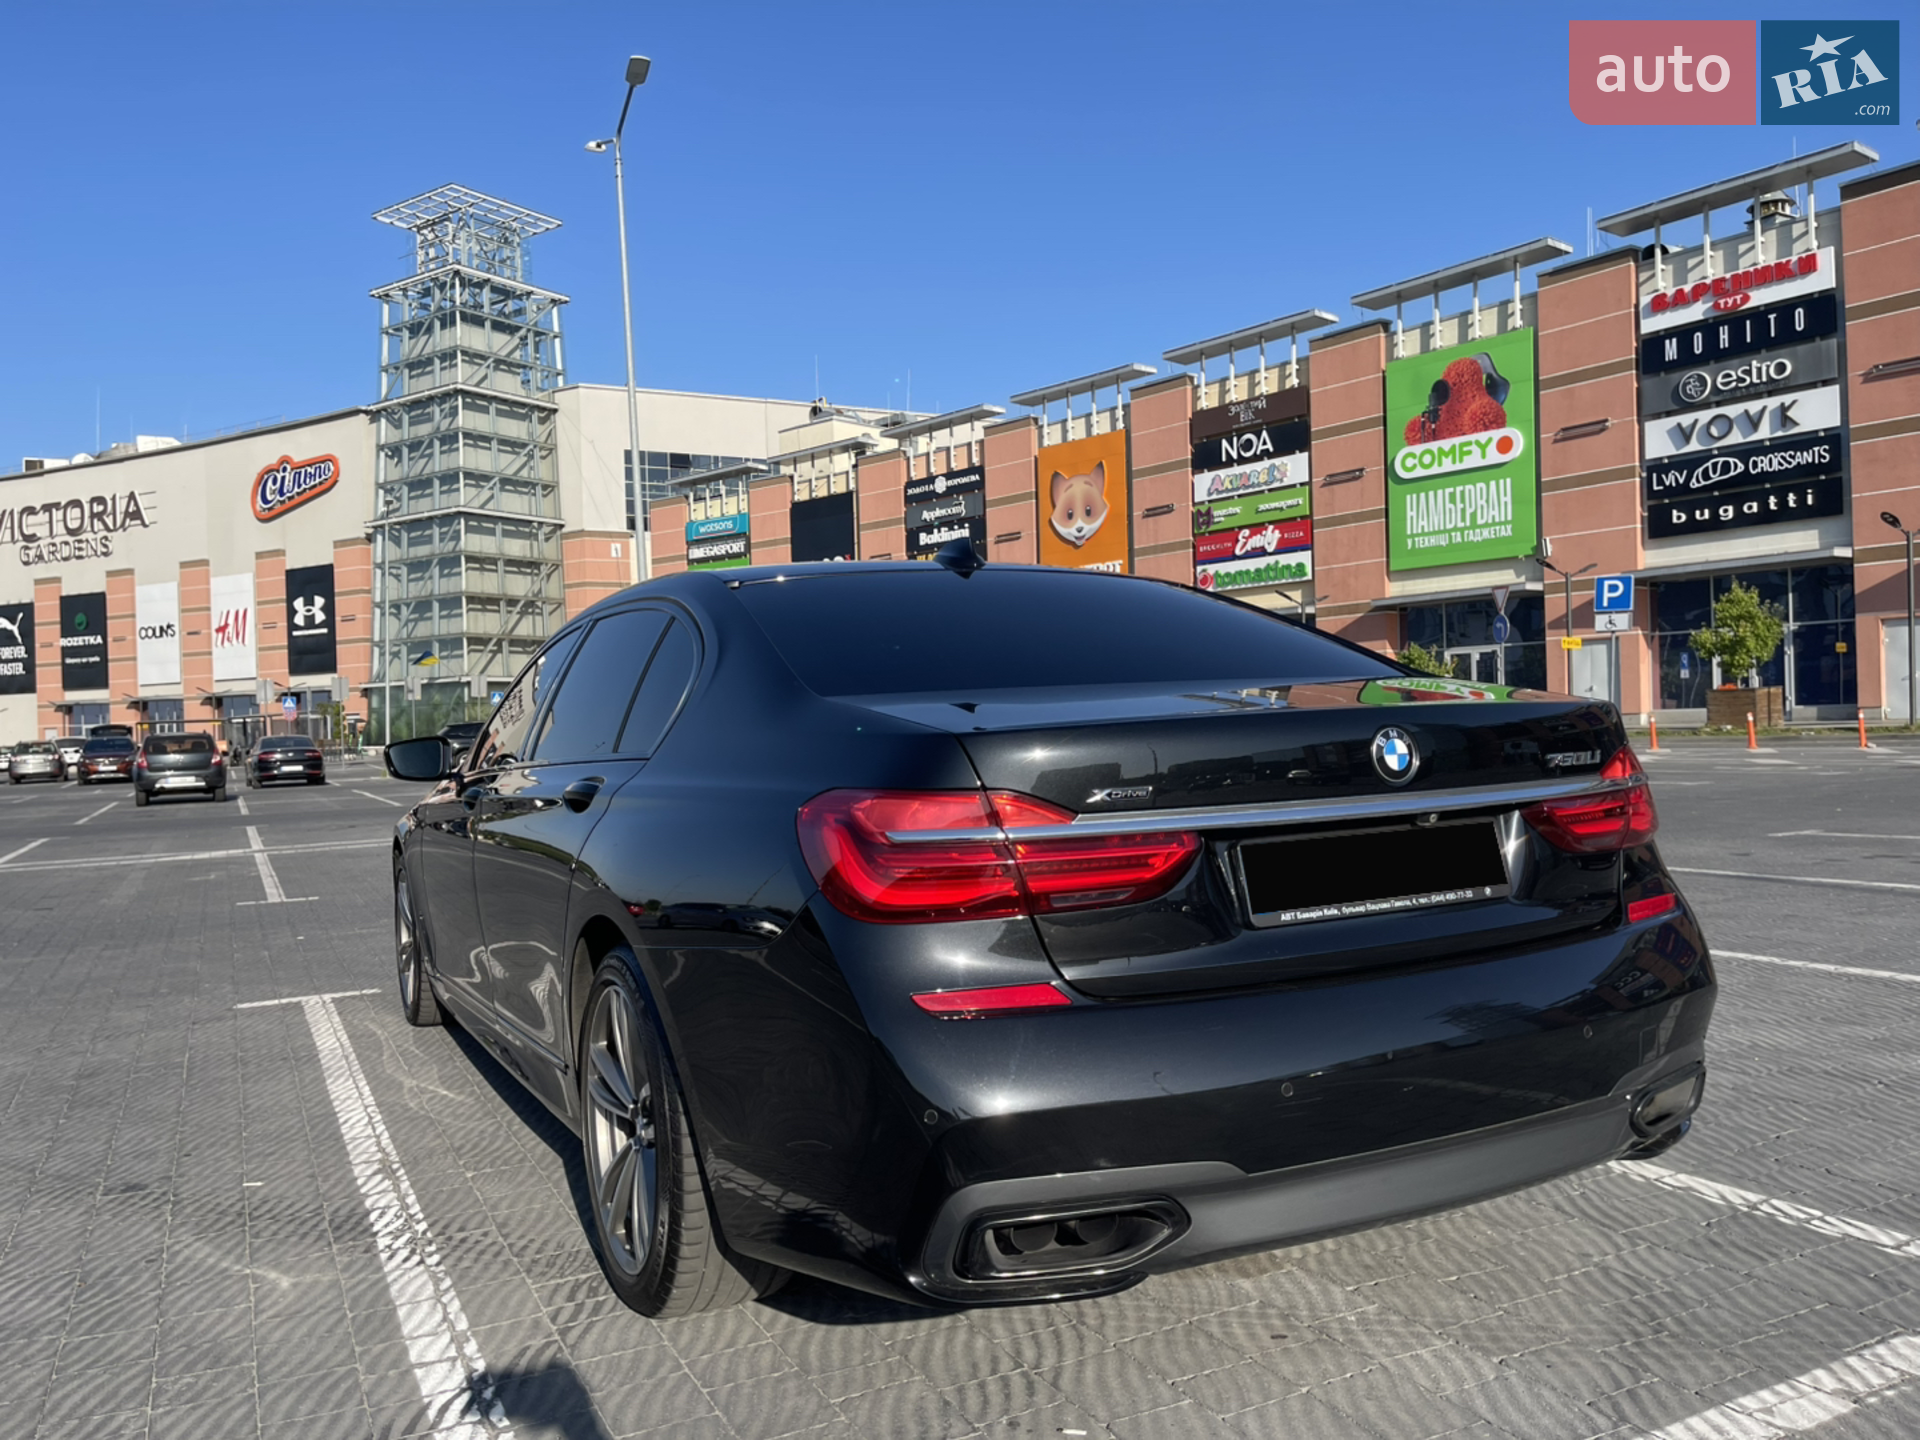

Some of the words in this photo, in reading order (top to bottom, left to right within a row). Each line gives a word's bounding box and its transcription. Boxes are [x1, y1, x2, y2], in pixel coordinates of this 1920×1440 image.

[1651, 253, 1818, 312] ВАРЕНИКИ
[1717, 294, 1744, 309] ТУТ
[1664, 307, 1805, 362] MOHITO
[1716, 358, 1792, 391] estro
[1676, 399, 1801, 446] VOVK
[1221, 429, 1274, 462] NOA
[1400, 437, 1493, 473] COMFY
[260, 463, 333, 508] Сільпо
[1406, 477, 1513, 535] НАМБЕРВАН
[1671, 489, 1814, 524] bugatti
[19, 535, 113, 566] GARDENS
[1235, 524, 1282, 556] Emily
[1451, 531, 1462, 544] ТА
[1464, 524, 1512, 543] ГАДЖЕТАХ
[1213, 560, 1307, 589] tomatina
[1602, 580, 1624, 607] P
[60, 635, 103, 647] ROZETKA
[1376, 729, 1411, 747] BMW
